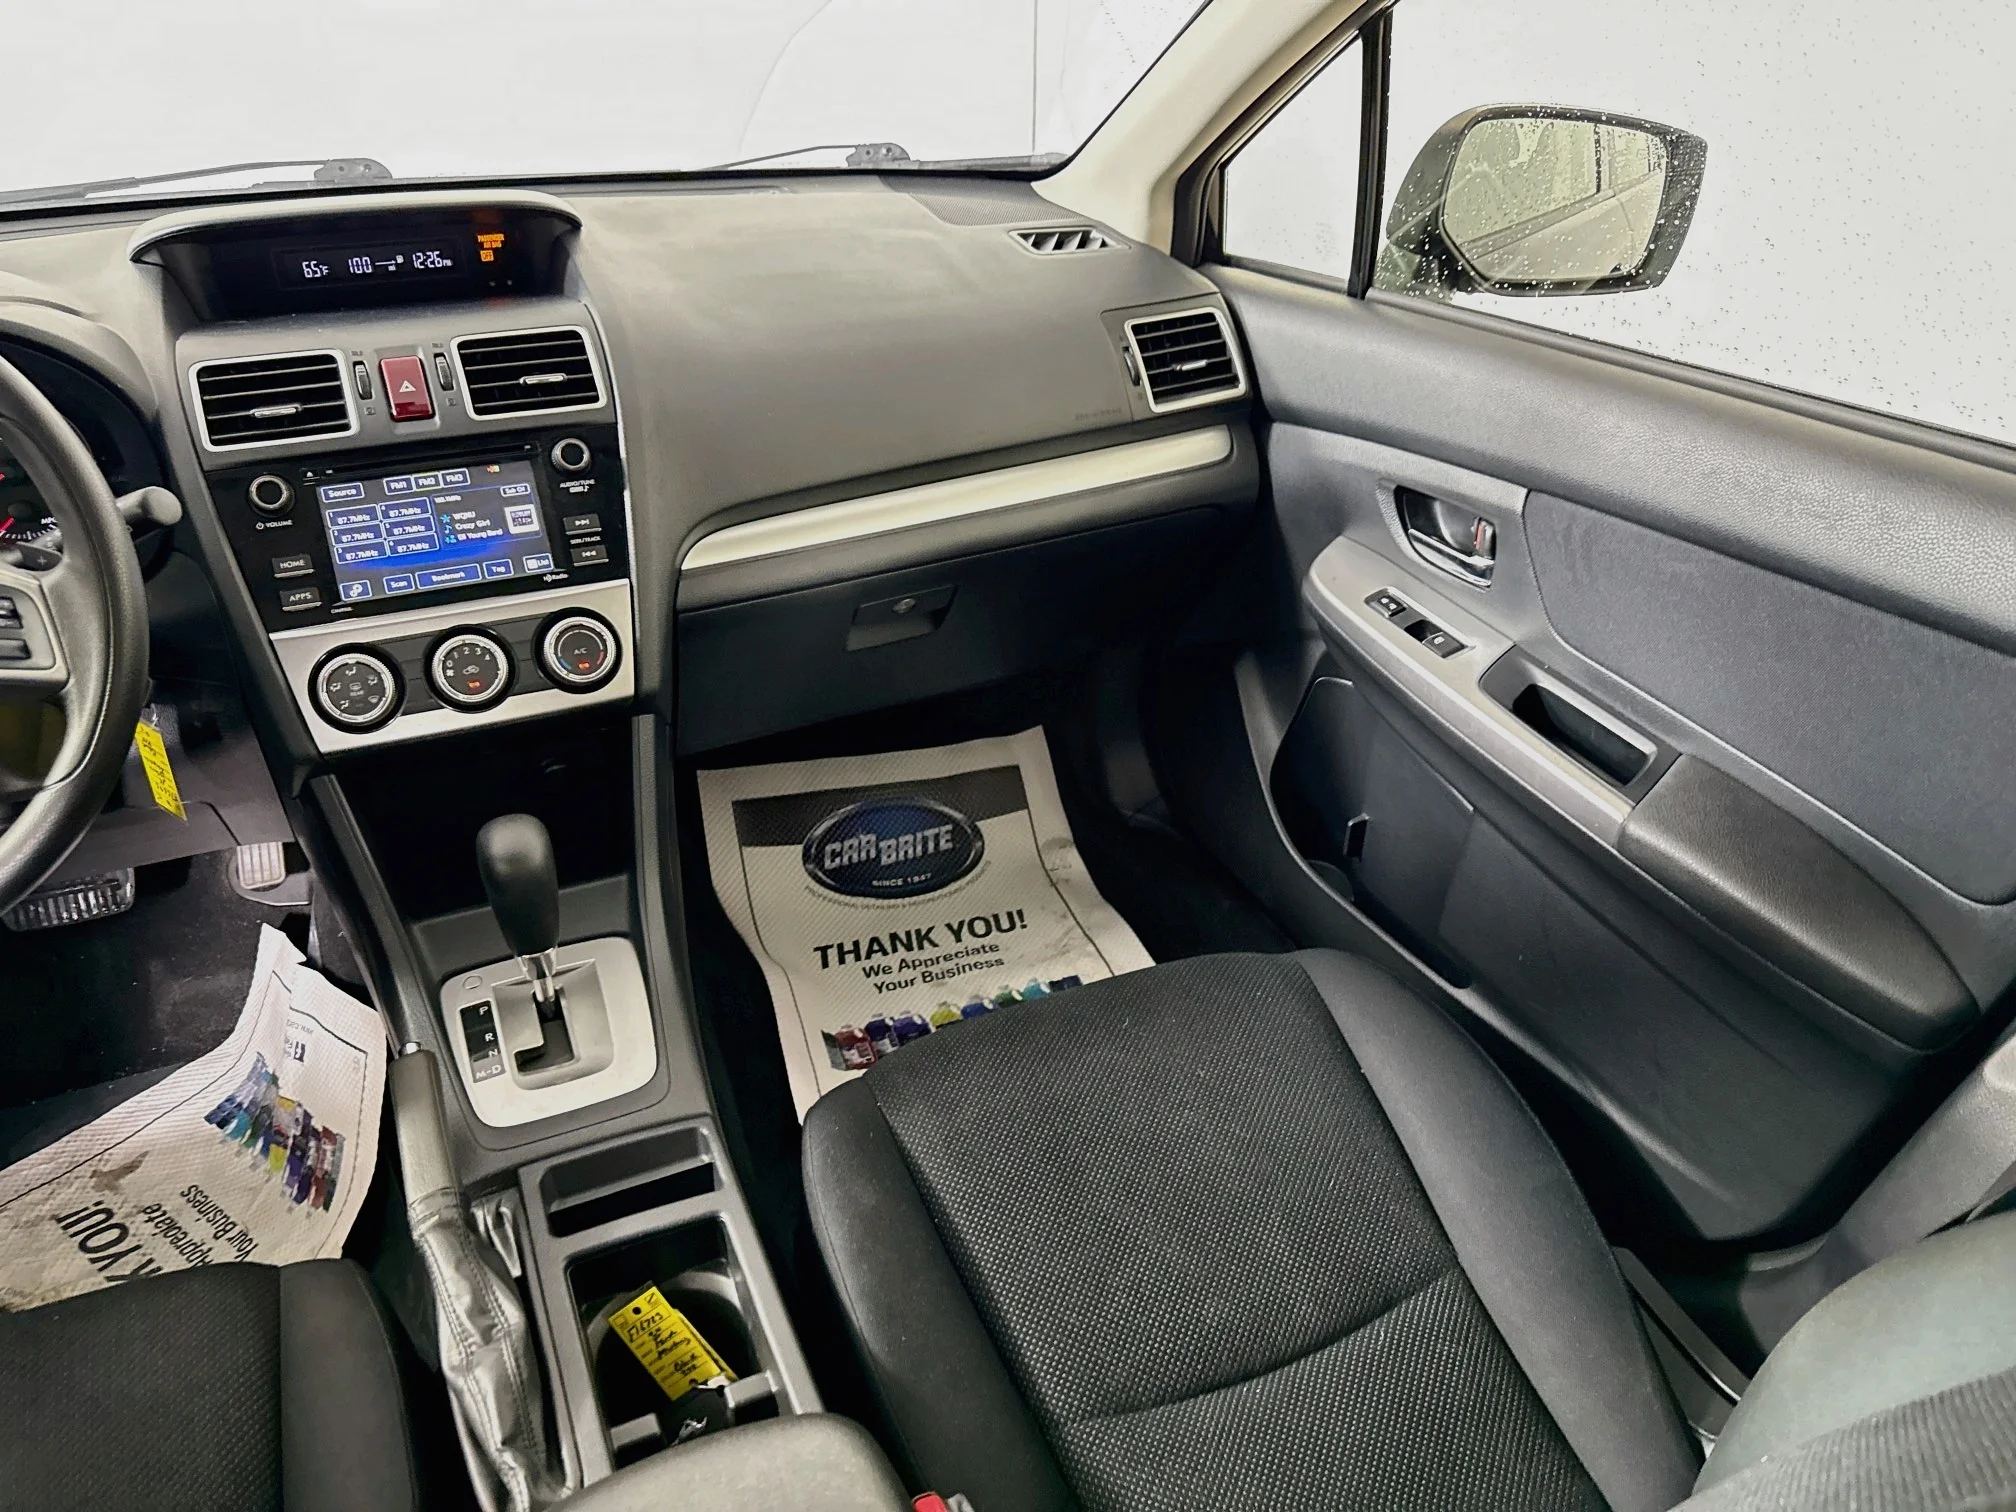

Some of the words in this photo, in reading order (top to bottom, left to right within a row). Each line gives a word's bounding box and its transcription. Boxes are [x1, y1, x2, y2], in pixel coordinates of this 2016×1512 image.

[348, 257, 373, 274] 100
[328, 488, 357, 498] Source
[265, 520, 293, 528] VOLUME
[280, 559, 306, 569] HOME
[390, 580, 408, 589] Scan
[289, 591, 312, 602] APPS
[463, 647, 470, 655] 2
[475, 647, 482, 655] 3
[573, 647, 587, 655] A/C
[824, 833, 877, 870] CAR
[879, 823, 954, 866] BRITE
[871, 877, 904, 887] SINCE
[813, 925, 940, 970] THANK
[944, 908, 1029, 944] YOU!
[862, 964, 894, 979] We
[898, 942, 1000, 973] Appreciate
[873, 977, 917, 995] Your
[921, 956, 1005, 984] Business
[479, 1006, 489, 1016] P
[485, 1032, 495, 1042] R
[488, 1049, 499, 1058] N
[180, 1184, 239, 1241] Business
[55, 1200, 144, 1273] YOU!
